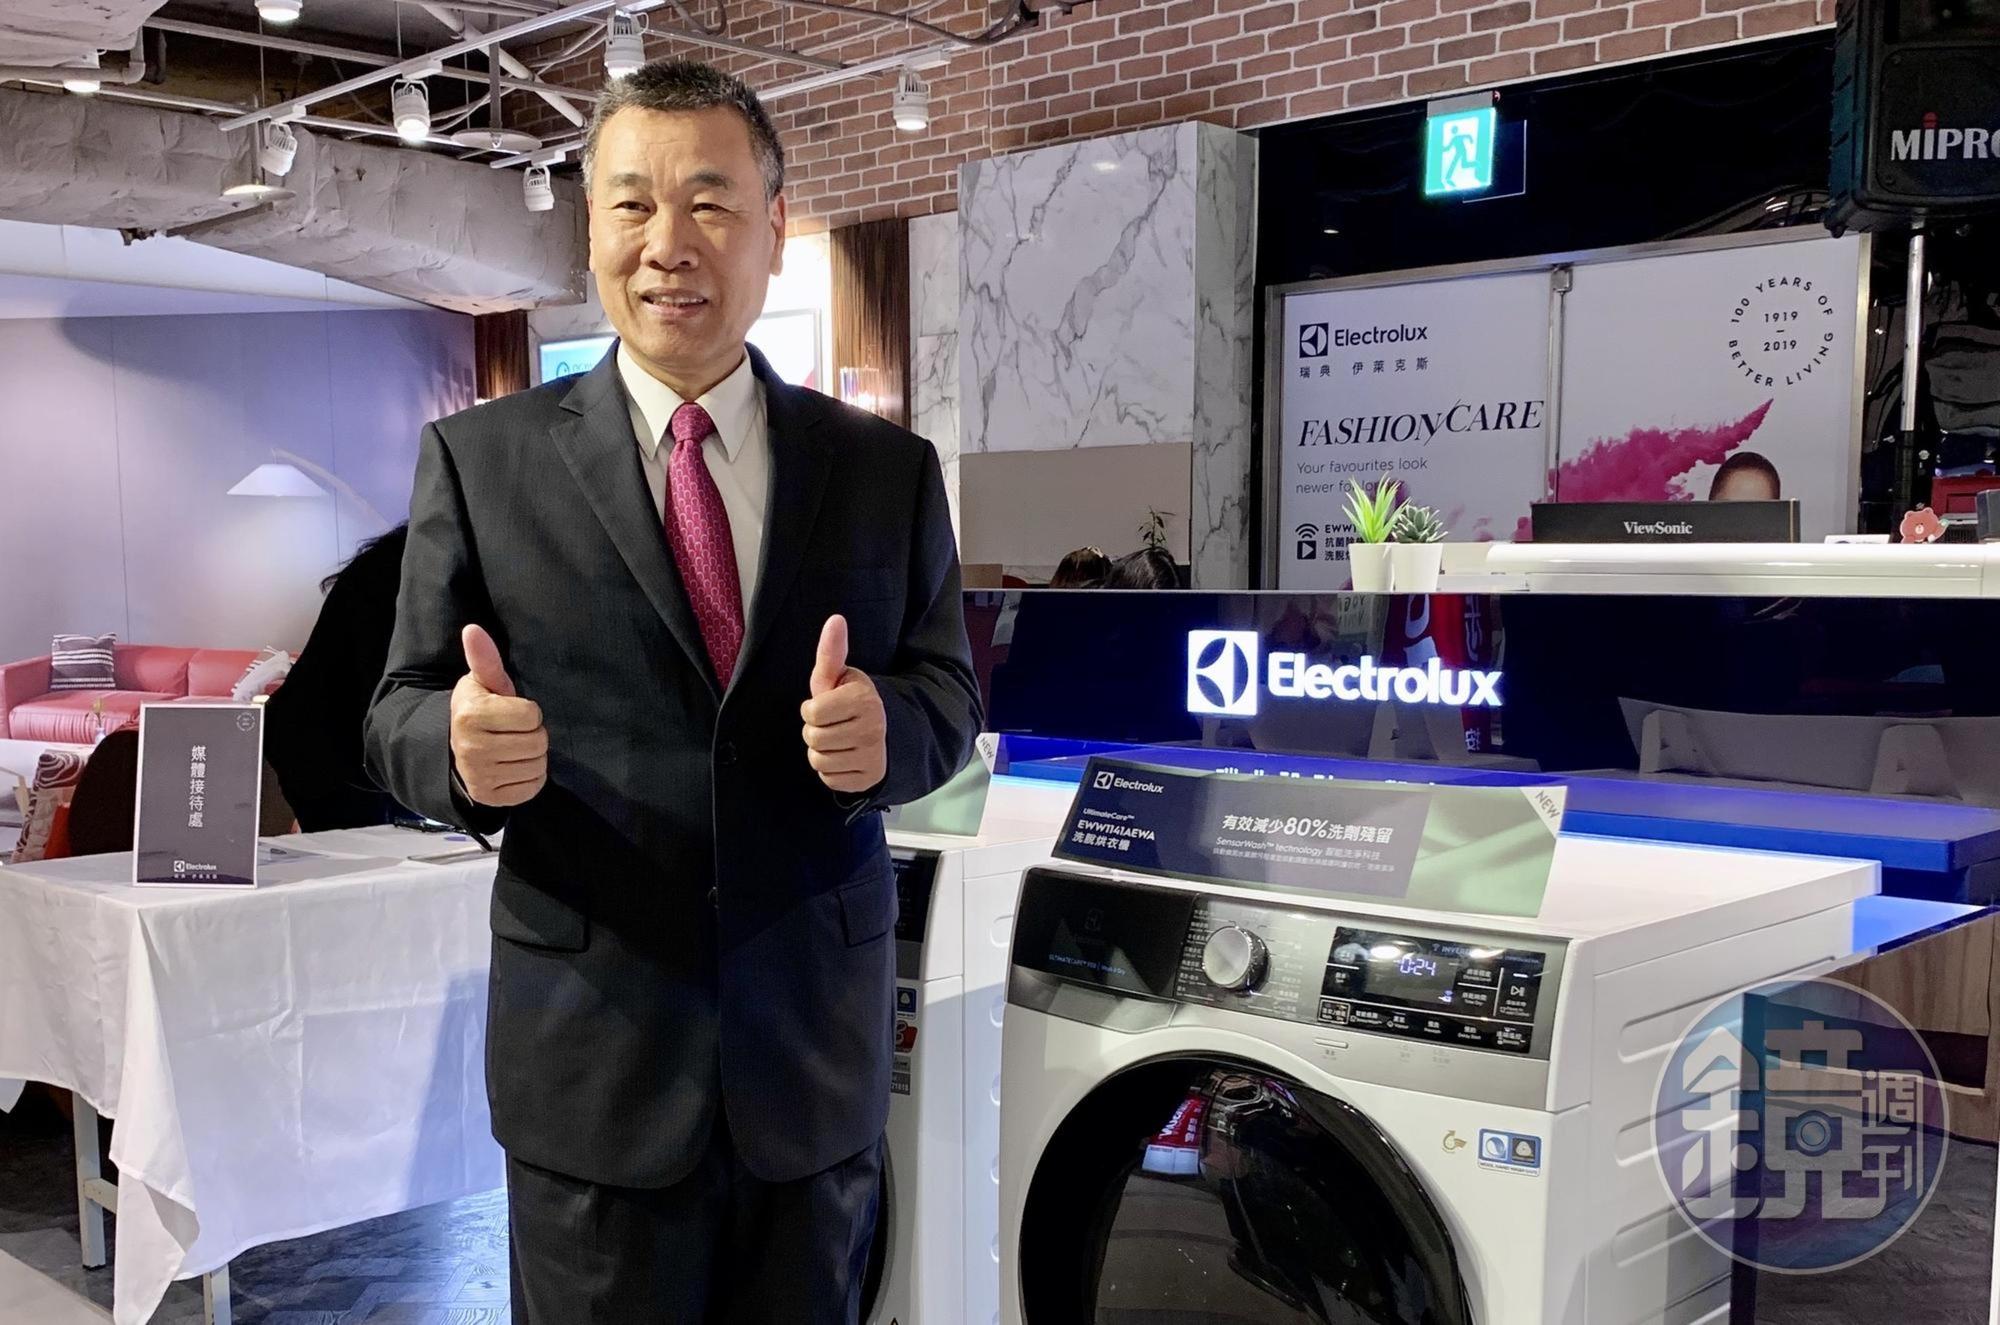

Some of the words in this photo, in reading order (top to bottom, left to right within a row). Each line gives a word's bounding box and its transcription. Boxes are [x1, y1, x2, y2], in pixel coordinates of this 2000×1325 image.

[1730, 297, 1750, 323] 100
[1755, 277, 1812, 293] YEARS
[1817, 295, 1834, 315] OF
[1764, 311, 1798, 323] 1919
[1334, 324, 1428, 347] Electrolux
[1763, 340, 1797, 352] 2019
[1728, 340, 1774, 387] BETTER
[1785, 332, 1834, 385] LIVING
[1297, 461, 1325, 474] Your
[1329, 459, 1394, 473] favourites
[1398, 457, 1428, 470] look
[1295, 483, 1333, 494] newer
[1623, 521, 1693, 534] ViewSonic
[1267, 651, 1503, 707] Electrolux
[980, 737, 994, 758] NEW
[188, 745, 206, 828] 媒體接待處
[1114, 777, 1165, 794] Electrolux
[1535, 790, 1561, 818] NEW
[1221, 814, 1394, 845] 有效減少80%洗劑殘留
[1275, 842, 1324, 857] technology
[1400, 956, 1437, 976] 0:24
